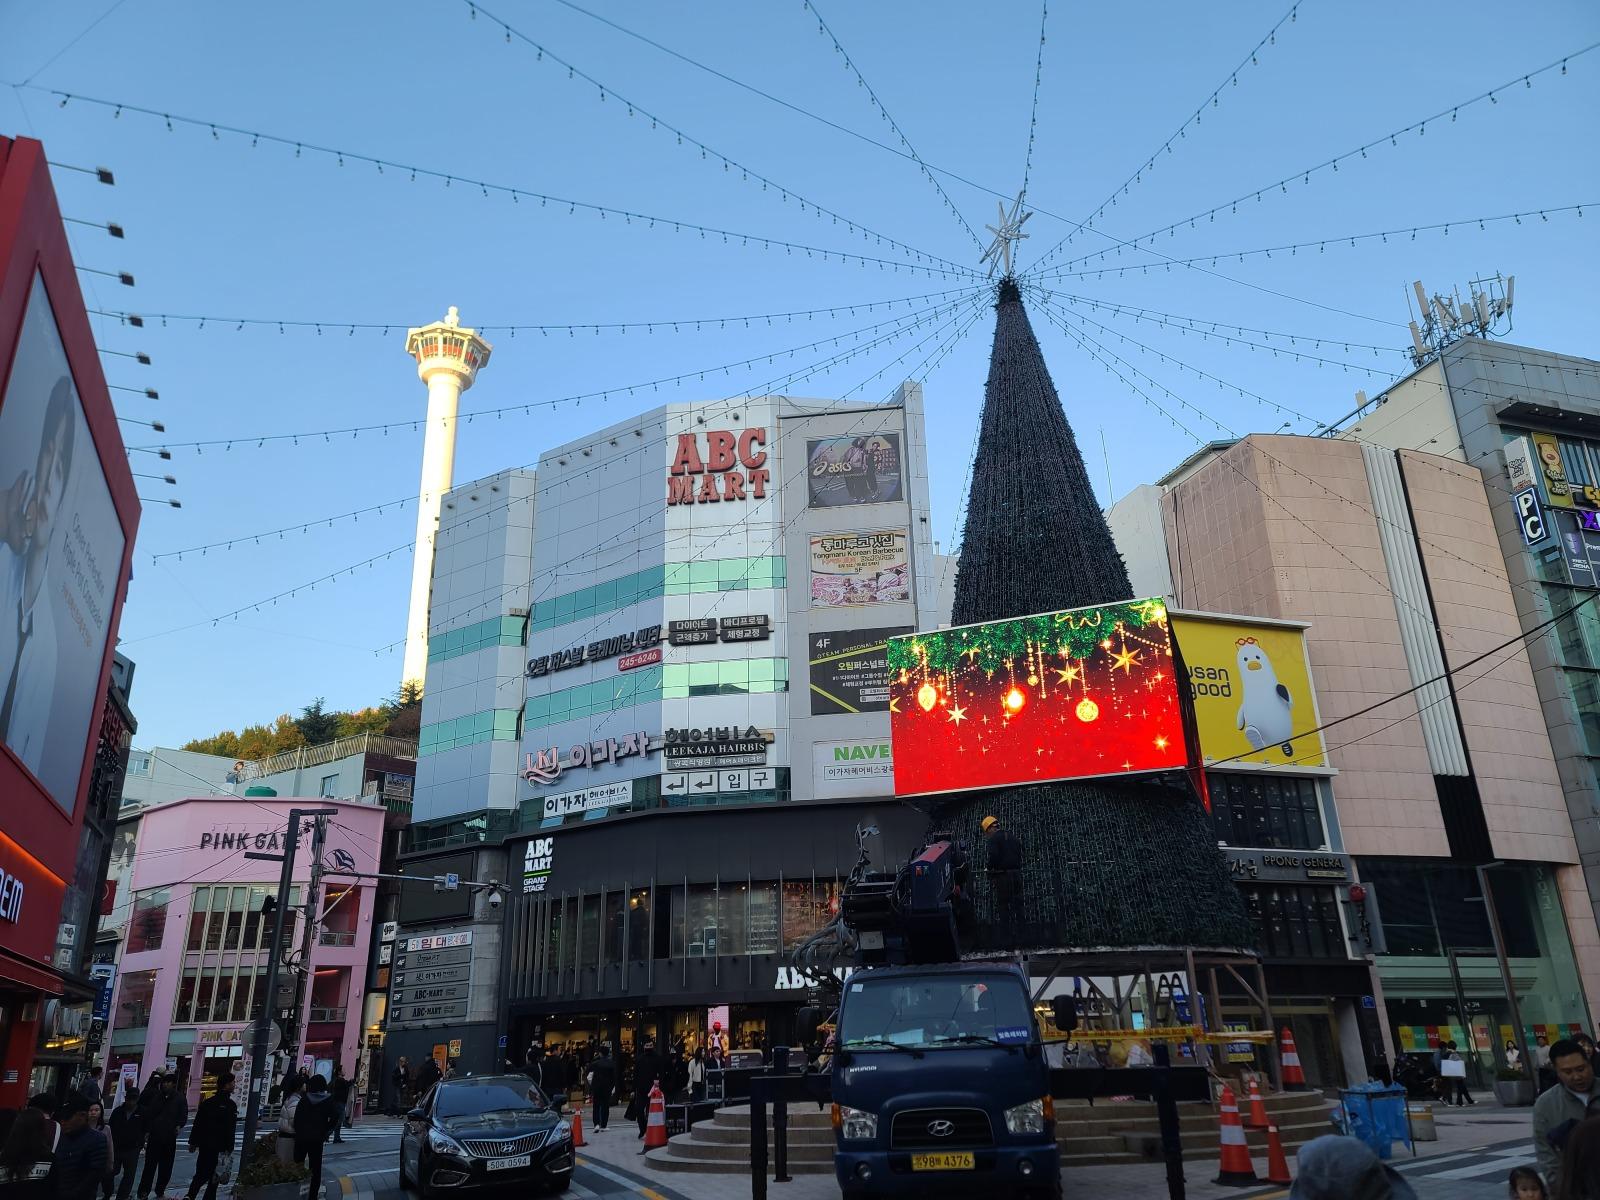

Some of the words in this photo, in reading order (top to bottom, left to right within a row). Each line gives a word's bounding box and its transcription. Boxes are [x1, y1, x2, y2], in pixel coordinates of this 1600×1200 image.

[671, 428, 767, 475] ABC
[667, 469, 770, 506] MART
[847, 549, 871, 557] Korean
[676, 620, 708, 630] 다이어트
[724, 616, 764, 627] 바디프로필
[727, 628, 760, 639] 체형교정
[816, 638, 831, 649] 4F
[620, 651, 657, 669] 245-6246
[665, 726, 761, 742] 헤어비스
[569, 731, 650, 769] 이가자
[665, 746, 715, 757] LEEKAJA
[719, 742, 765, 753] HAIRBIS
[546, 793, 586, 812] 이가자
[589, 786, 628, 798] 헤어비스
[200, 832, 249, 850] PINK
[524, 836, 554, 859] ABC
[524, 856, 553, 872] MART
[1263, 855, 1300, 867] PPONG
[1302, 857, 1345, 870] GENERAL
[523, 876, 548, 885] GRAND
[523, 884, 545, 893] STAGE
[200, 1031, 223, 1042] PINK
[508, 1157, 527, 1167] 0594
[944, 1155, 970, 1168] 4376
